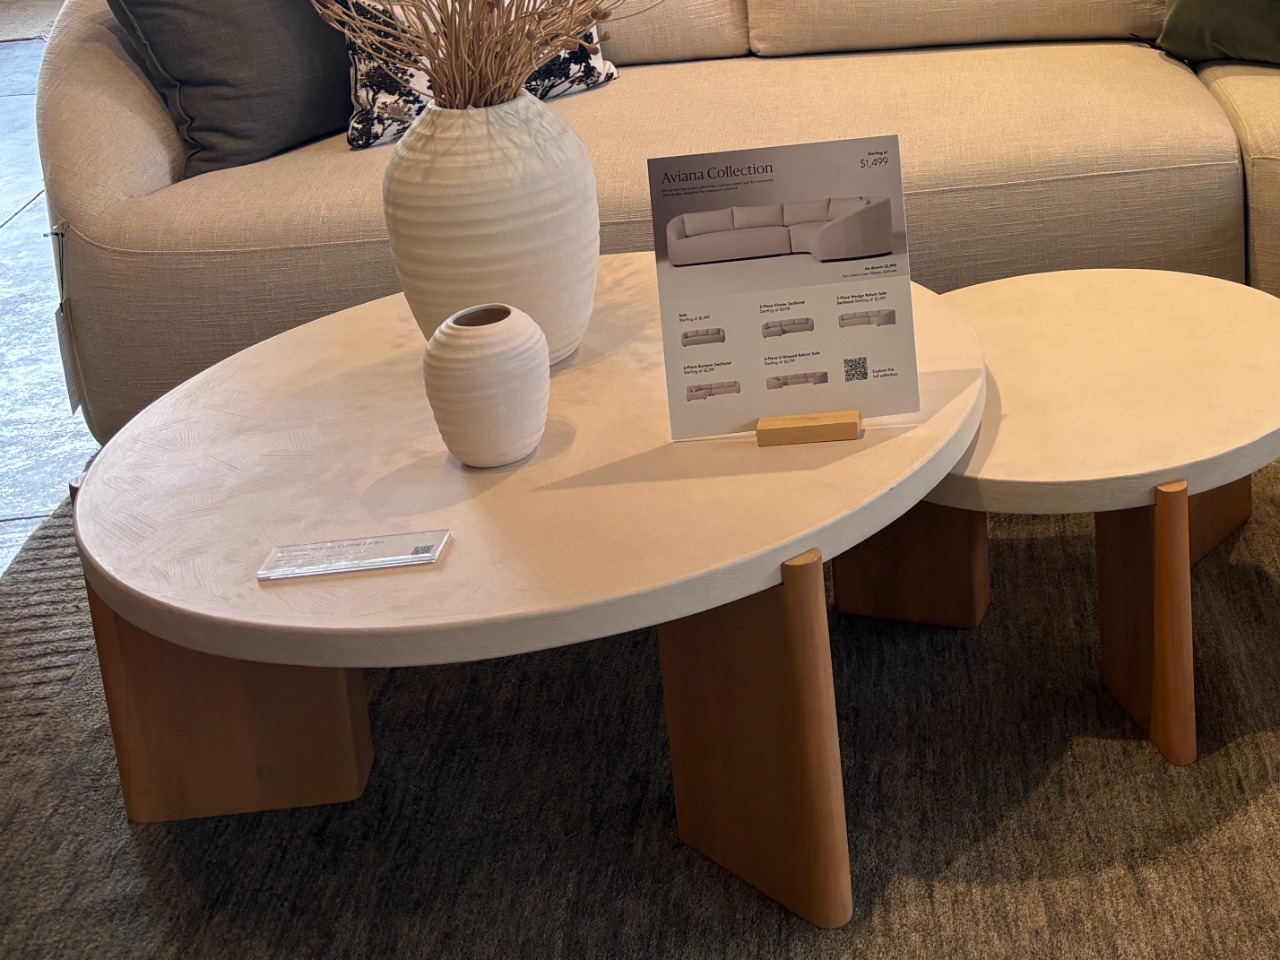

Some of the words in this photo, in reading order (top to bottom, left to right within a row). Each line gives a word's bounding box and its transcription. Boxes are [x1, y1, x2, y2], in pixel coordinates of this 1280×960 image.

[860, 157, 888, 169] $1,499
[662, 170, 705, 185] Aviana
[707, 163, 773, 179] Collection
